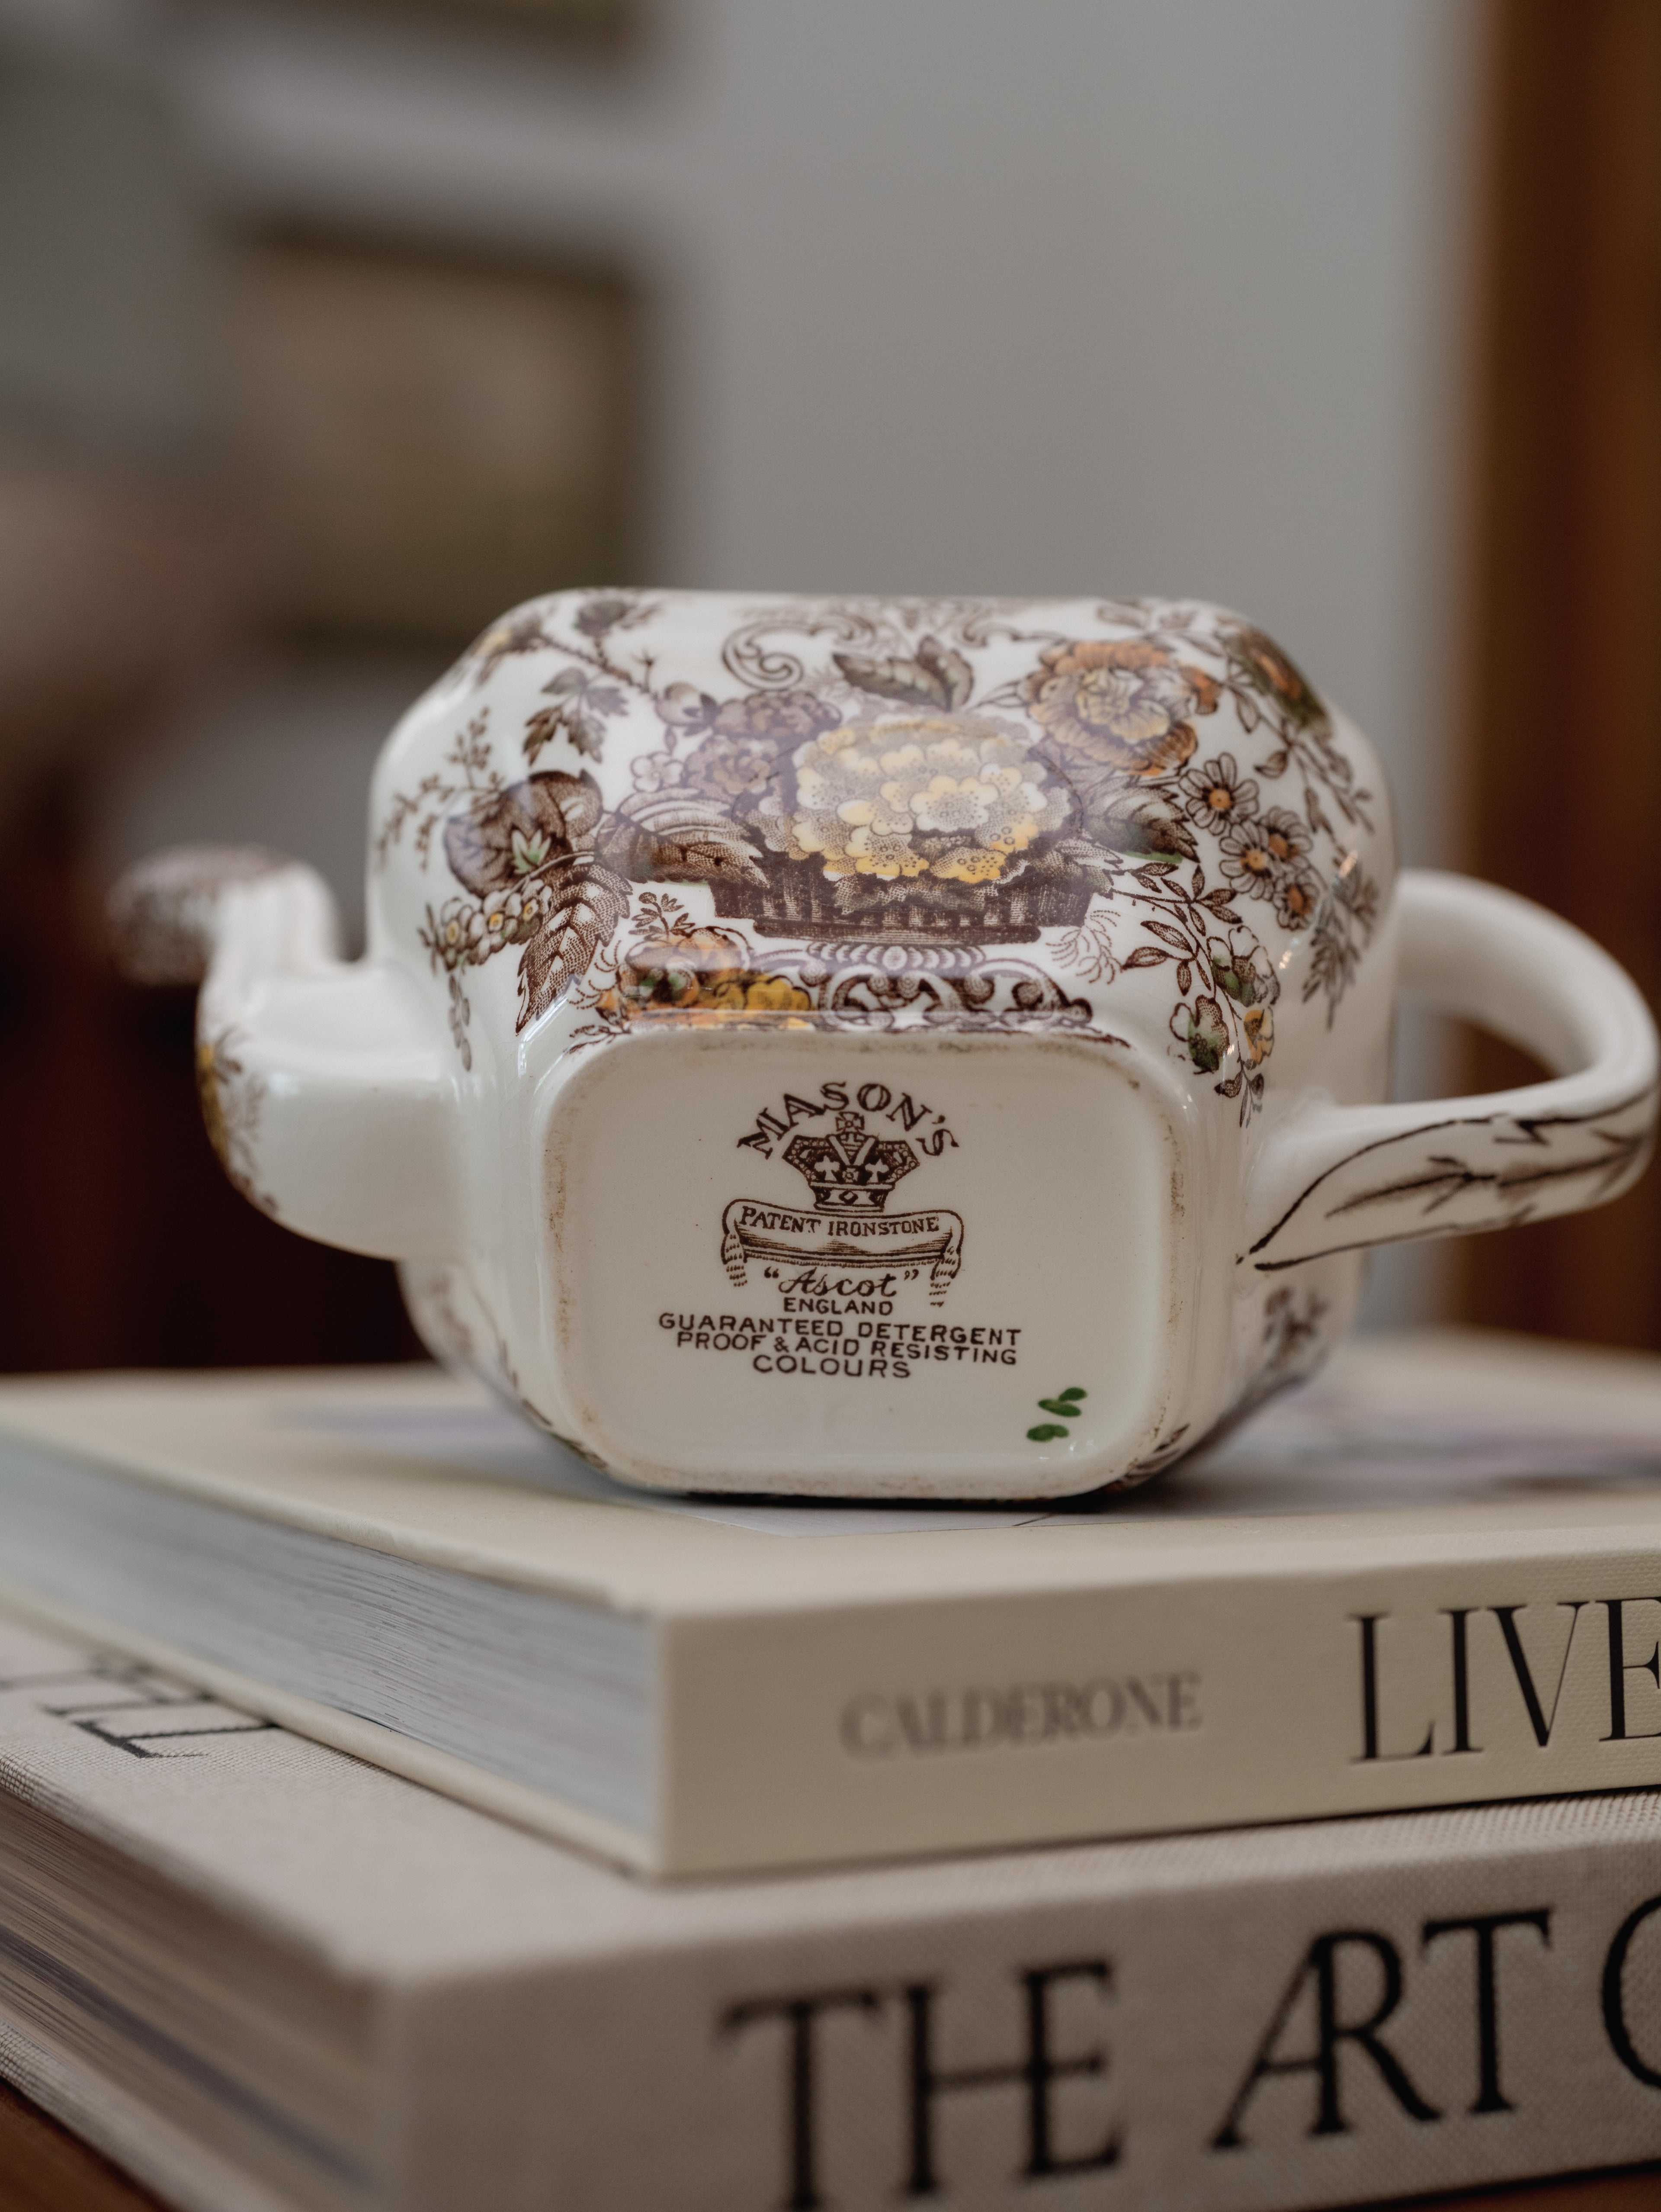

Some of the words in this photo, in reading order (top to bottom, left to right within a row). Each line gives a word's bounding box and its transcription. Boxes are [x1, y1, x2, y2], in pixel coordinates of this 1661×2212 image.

[737, 1081, 960, 1160] MASON'S
[739, 1206, 821, 1234] PATENT
[828, 1216, 939, 1237] IRONSTONE
[783, 1297, 893, 1316] ENGLAND
[658, 1312, 843, 1337] GUARANTEED
[858, 1321, 1021, 1346] DETERGENT
[677, 1332, 766, 1351] PROOF
[774, 1337, 789, 1352] &
[795, 1338, 859, 1356] ACID
[871, 1341, 1017, 1365] RESISTING
[753, 1354, 911, 1378] COLOURS
[839, 1670, 1202, 1761] CALDERONE
[1349, 1597, 1661, 1764] LIVE
[712, 1956, 1125, 2212] THE
[1205, 1908, 1554, 2150] ART
